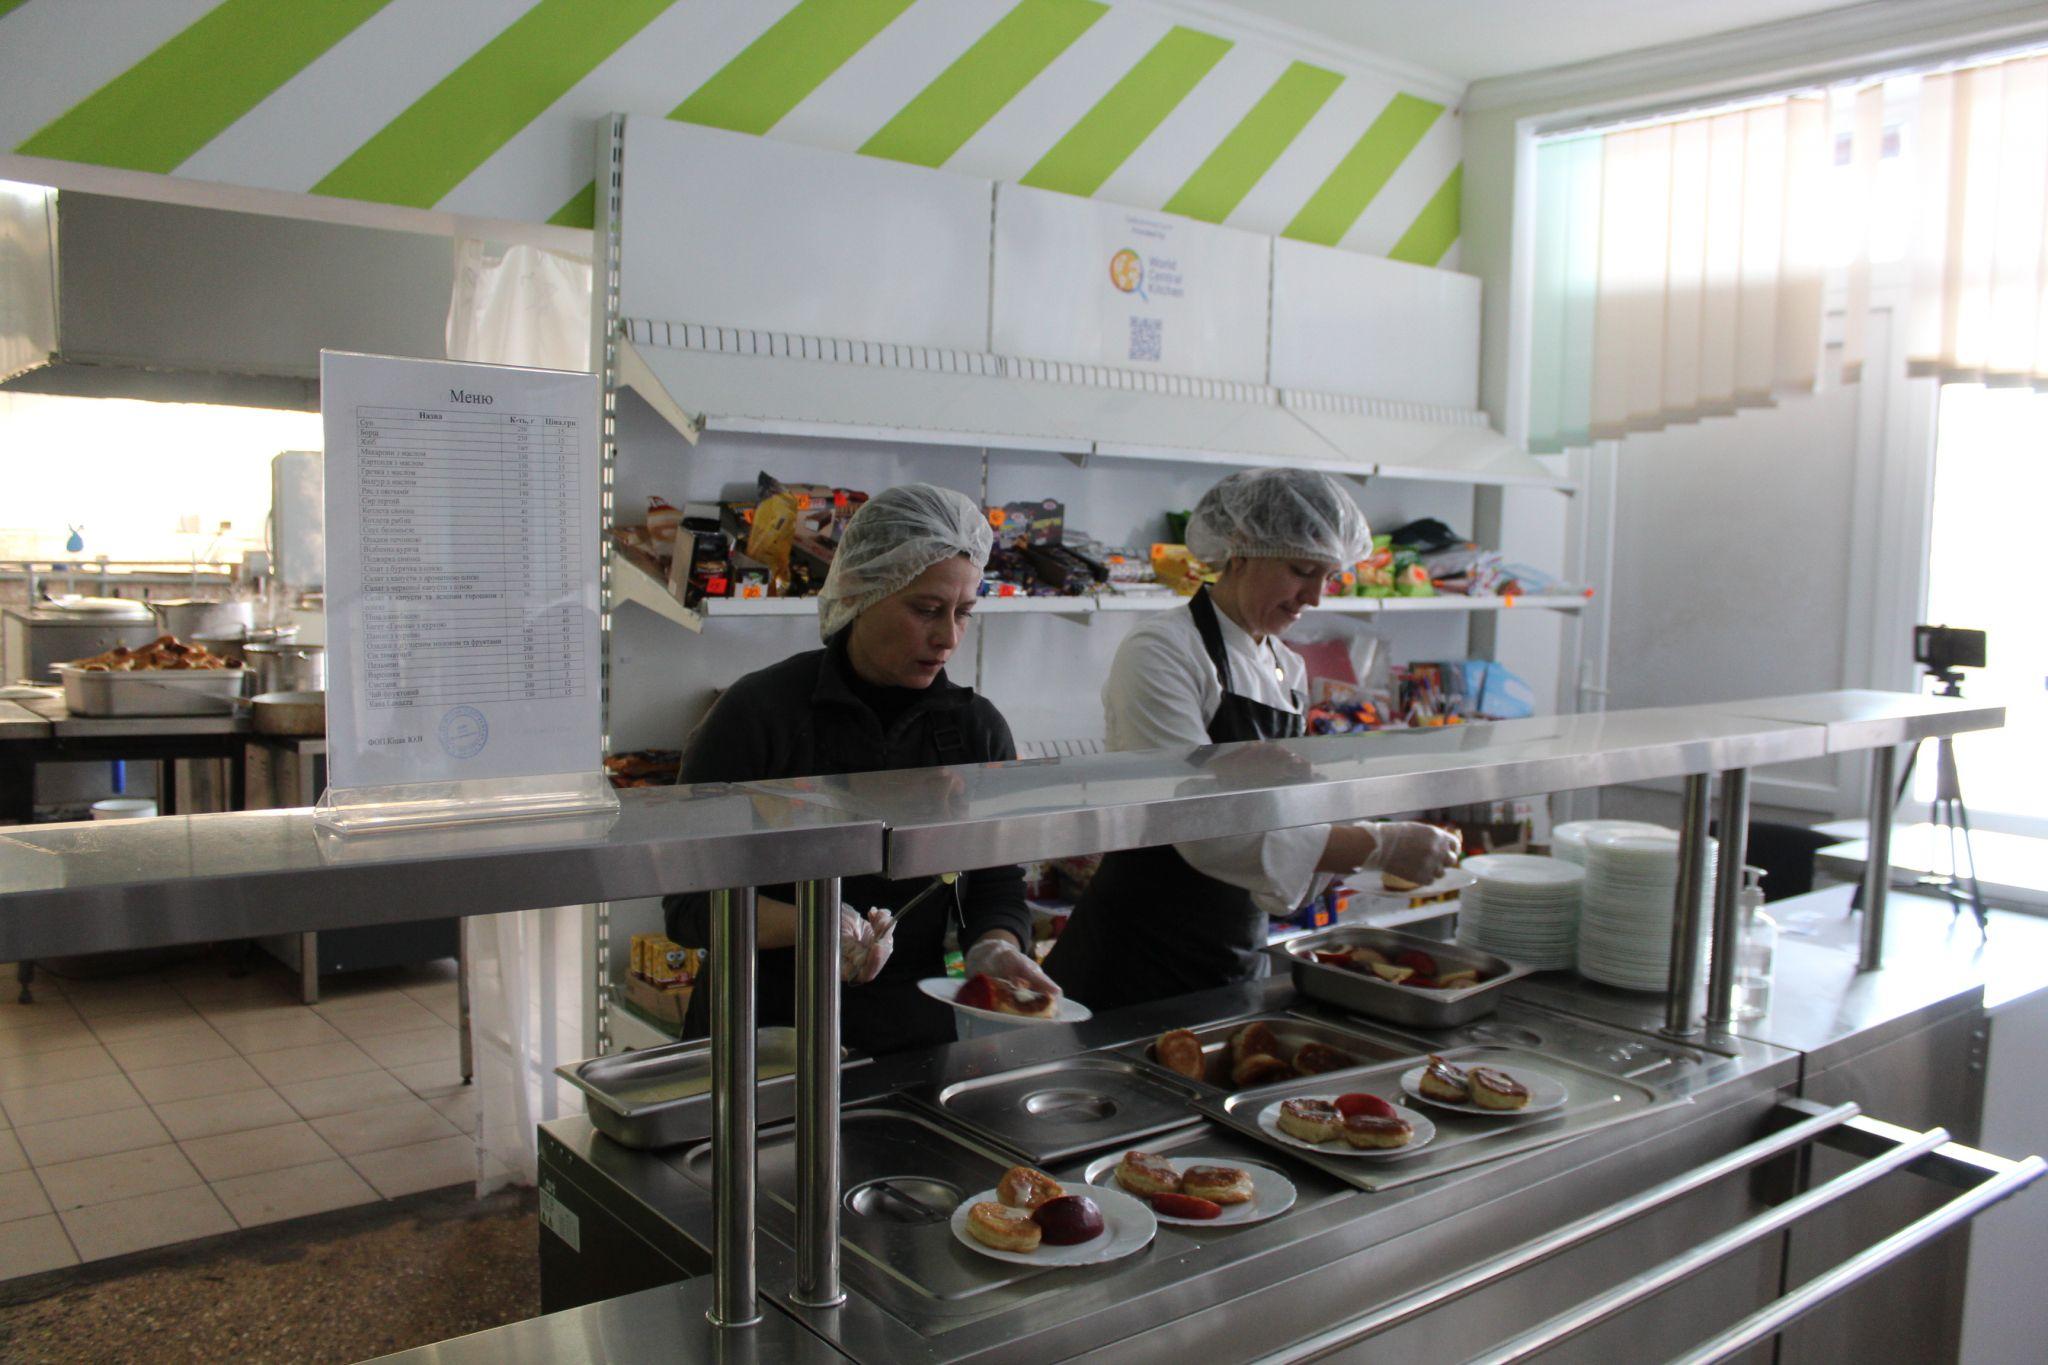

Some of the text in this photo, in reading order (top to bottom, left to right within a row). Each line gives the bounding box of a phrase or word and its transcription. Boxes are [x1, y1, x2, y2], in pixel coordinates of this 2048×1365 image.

[450, 389, 493, 405] Меню
[419, 412, 443, 420] Назва
[360, 420, 374, 428] Суп
[360, 429, 379, 437] Борщ
[360, 448, 395, 457] Макарони
[361, 468, 385, 476] Гречка
[471, 639, 502, 648] фруктами
